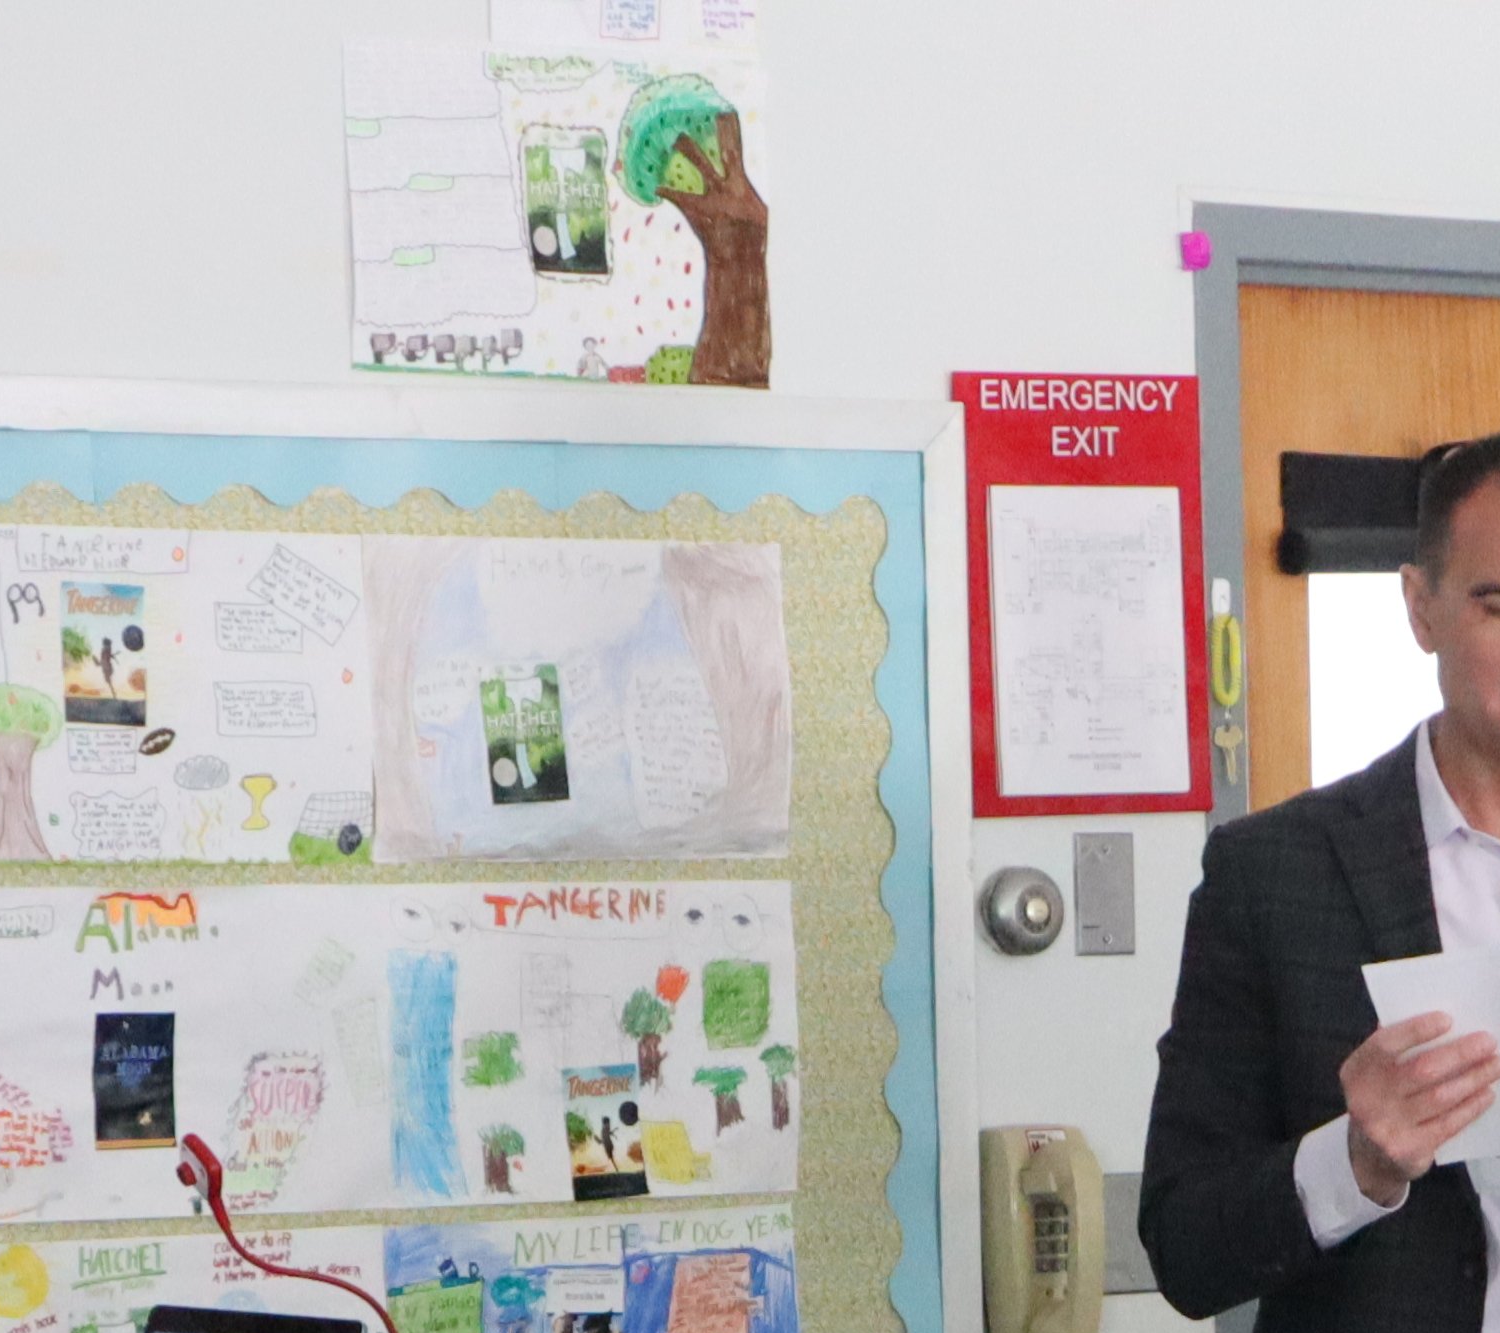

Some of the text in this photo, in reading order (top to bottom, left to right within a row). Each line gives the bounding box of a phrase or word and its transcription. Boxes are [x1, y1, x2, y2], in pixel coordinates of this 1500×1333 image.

[529, 182, 606, 197] HATCHET
[980, 380, 1178, 411] EMERGENCY
[1052, 427, 1119, 456] EXIT
[485, 709, 558, 727] HATCHET
[484, 887, 666, 926] TANGERINE
[567, 1076, 633, 1099] TANGERINE
[513, 1229, 559, 1267] MY
[692, 1218, 734, 1244] DOG
[78, 1242, 164, 1278] HATCHET
